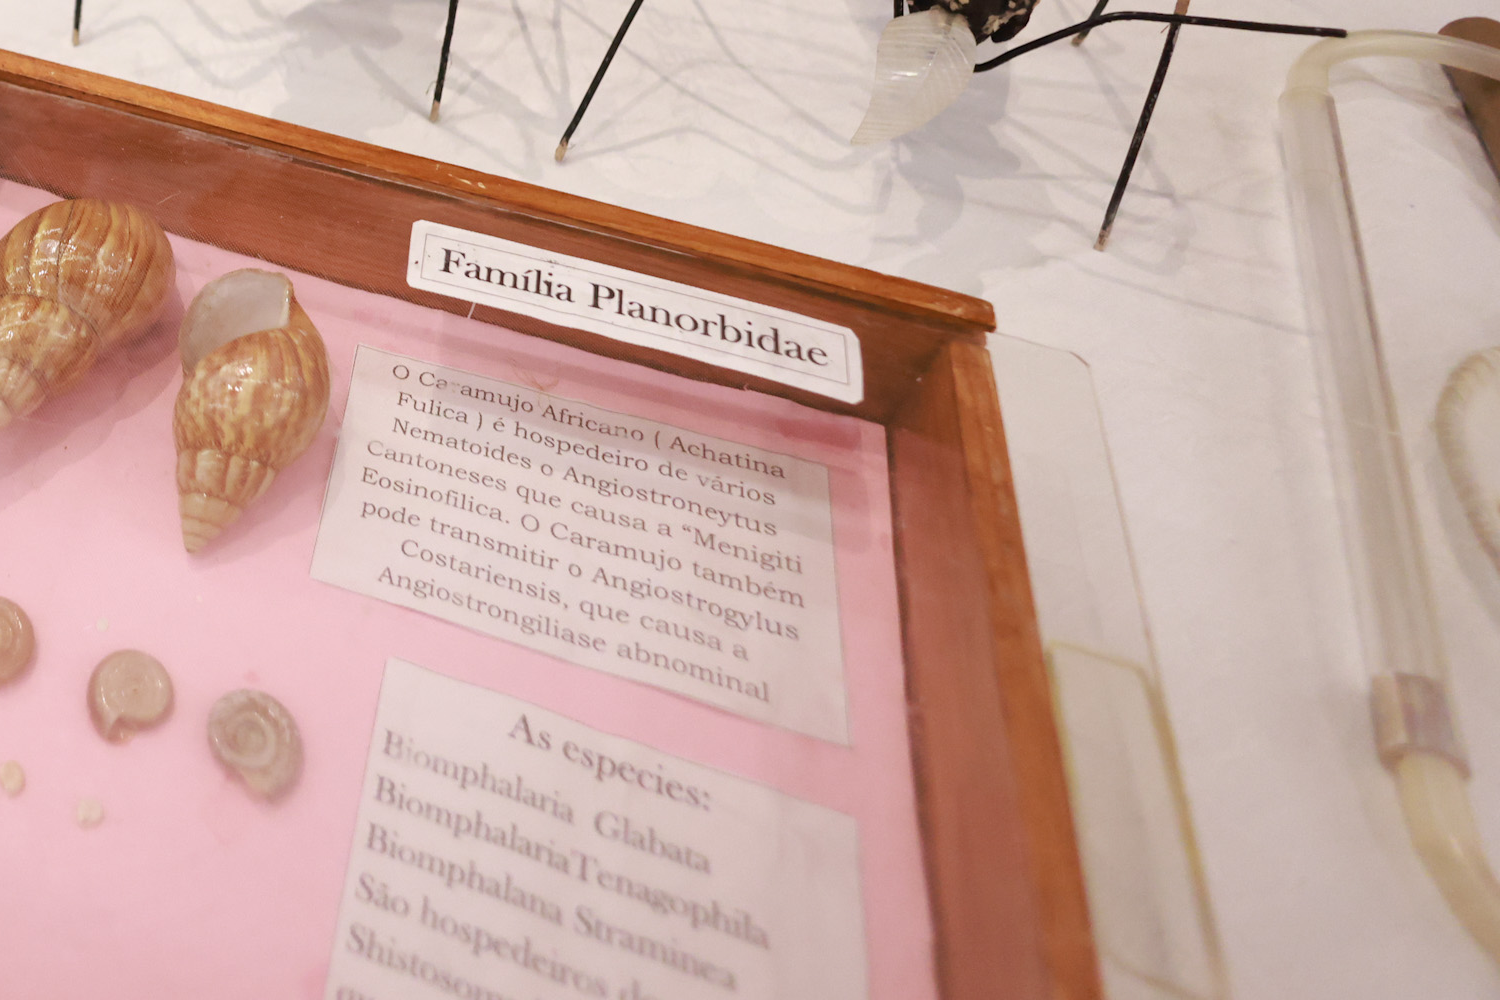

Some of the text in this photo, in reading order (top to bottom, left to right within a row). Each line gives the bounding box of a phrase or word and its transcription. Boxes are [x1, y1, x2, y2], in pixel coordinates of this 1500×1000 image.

[439, 246, 830, 368] Família Planorbidae
[392, 364, 787, 480] O Caamujo Africano ( Achatina
[392, 417, 778, 536] Nematoides o Angiostroneytus
[396, 391, 470, 425] Fulica
[492, 416, 507, 433] é
[514, 420, 649, 472] hospedeiro
[658, 461, 689, 481] de
[697, 475, 776, 506] vários
[360, 466, 807, 608] Eosinofilica. O Caramujo também
[367, 440, 508, 492] Cantoneses
[515, 484, 562, 509] que
[570, 500, 649, 533] causa
[657, 522, 673, 538] a
[360, 500, 801, 642] pode transmitir o Angiostrogylus
[400, 538, 750, 661] Costariensis, que causa a
[378, 566, 770, 703] Angiostrongiliase abnominal
[384, 728, 714, 876] Biomphalaria Glabata
[507, 713, 711, 812] As especies:
[353, 872, 412, 920] São
[419, 893, 608, 999] hospedeiros
[573, 904, 740, 993] Straminea
